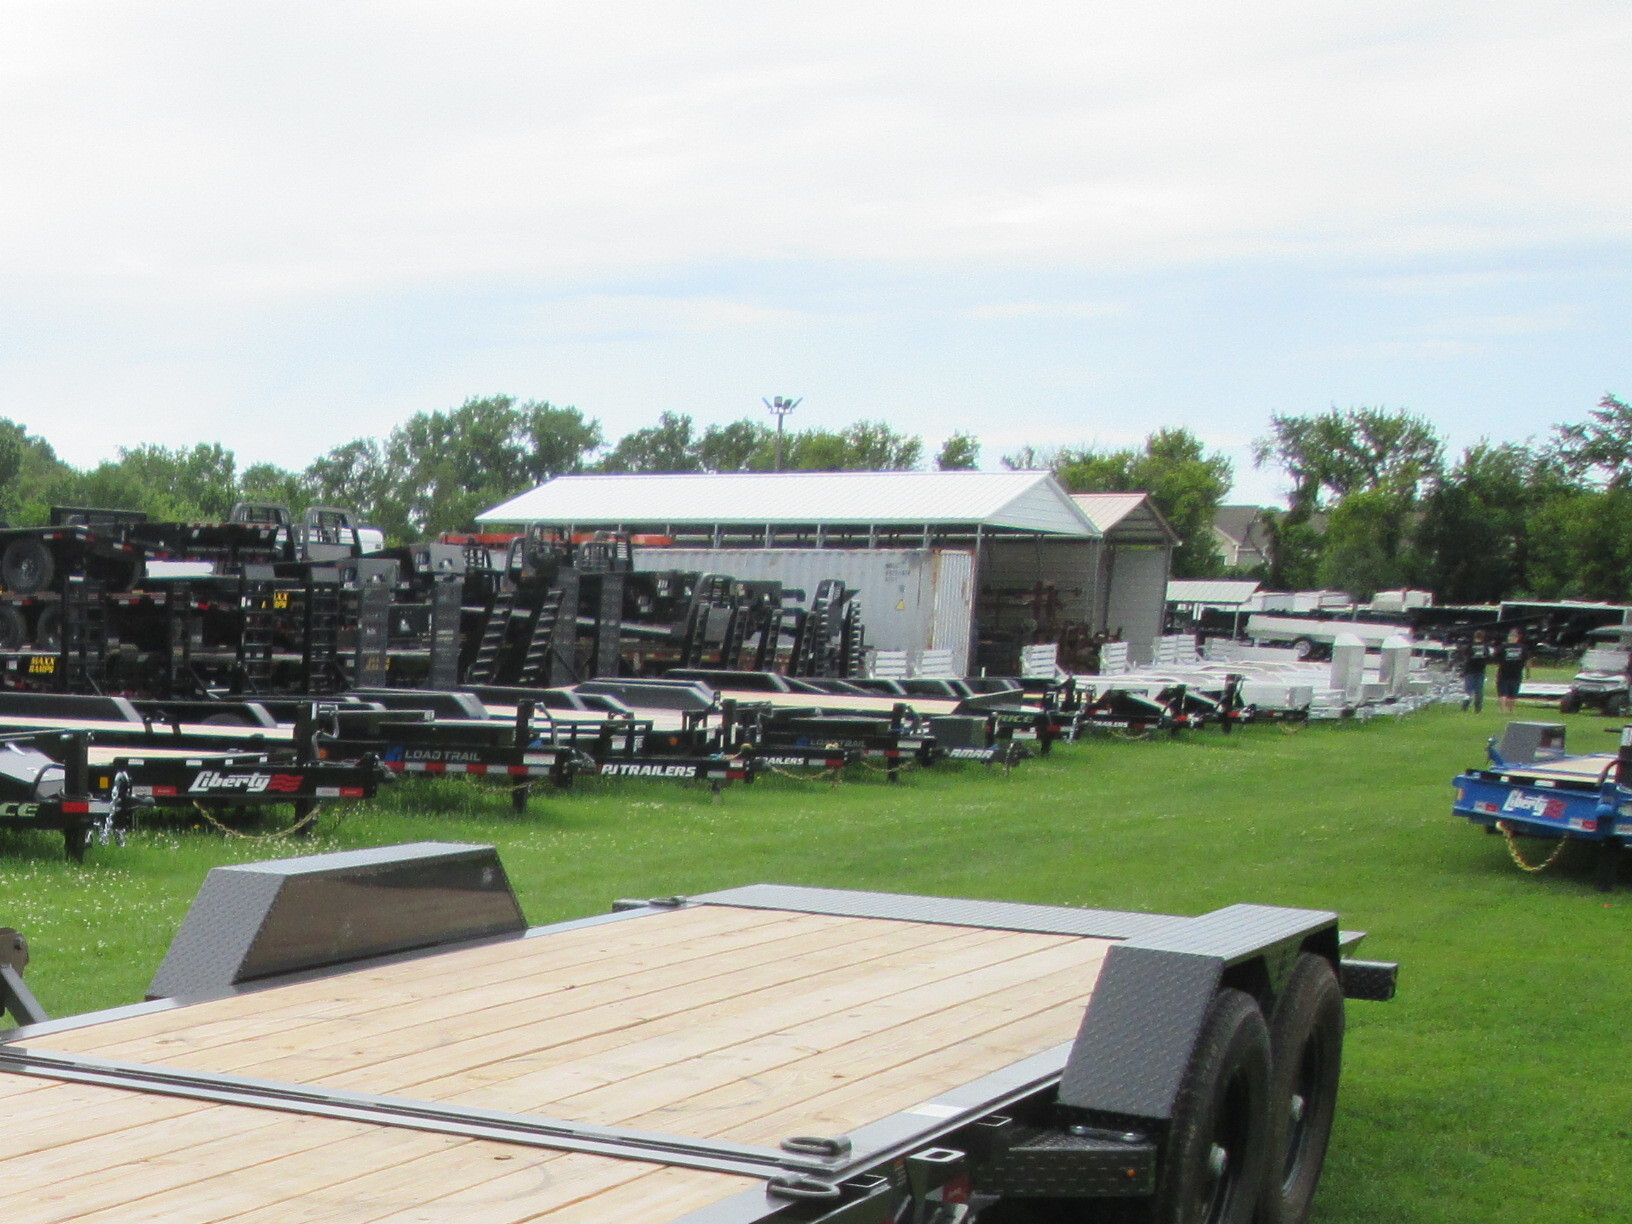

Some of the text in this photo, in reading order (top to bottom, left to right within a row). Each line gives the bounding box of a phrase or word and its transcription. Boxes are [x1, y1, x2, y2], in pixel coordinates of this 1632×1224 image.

[949, 748, 994, 758] AMAR
[601, 764, 696, 777] PJ TRAILERS
[188, 771, 271, 792] Liberty
